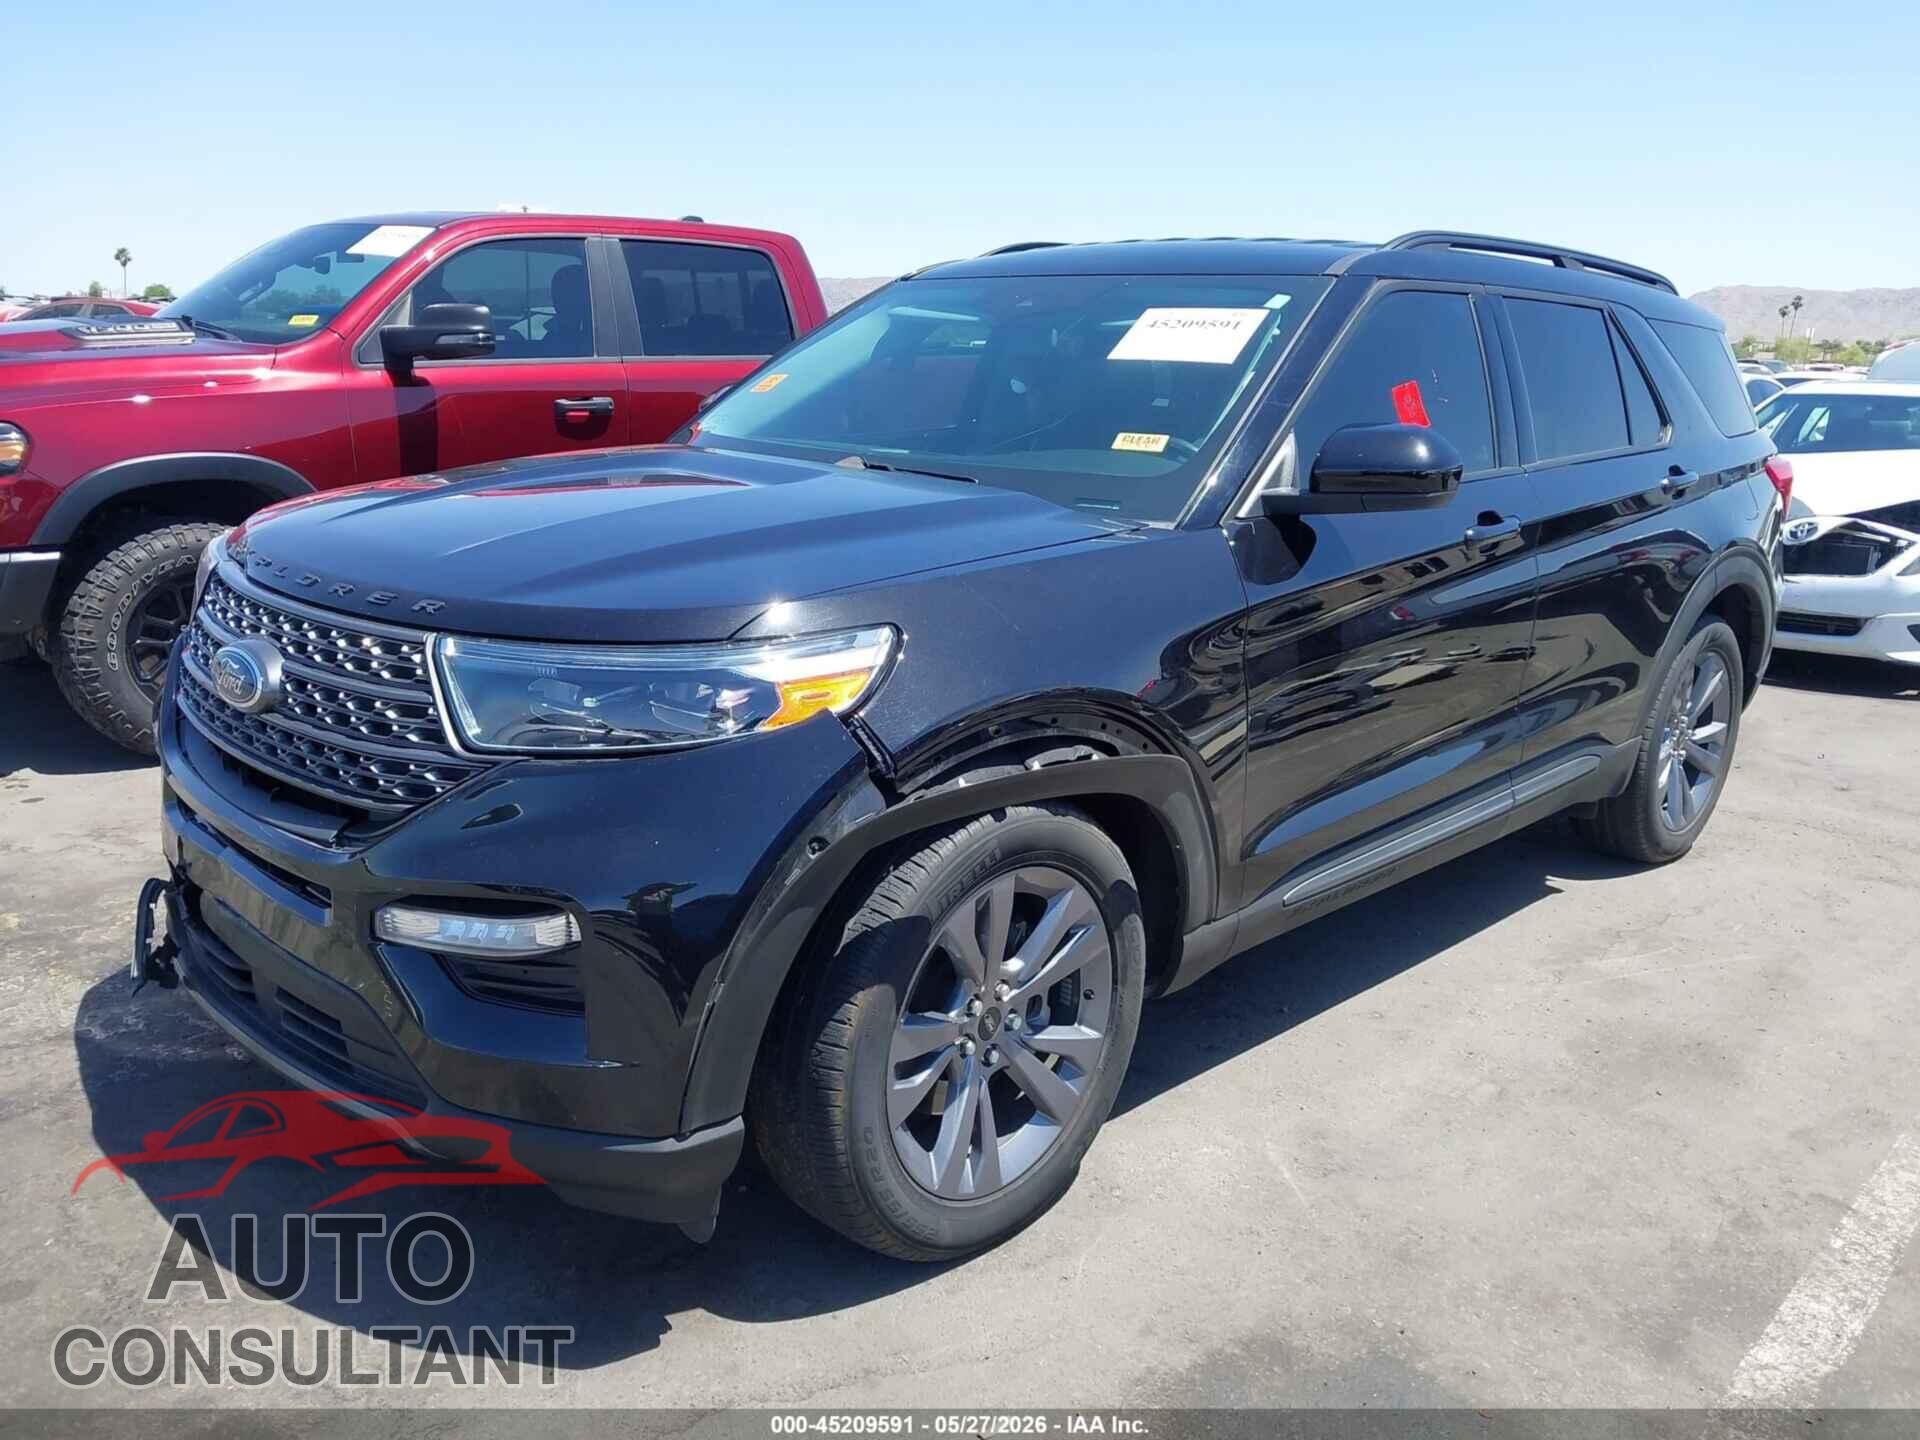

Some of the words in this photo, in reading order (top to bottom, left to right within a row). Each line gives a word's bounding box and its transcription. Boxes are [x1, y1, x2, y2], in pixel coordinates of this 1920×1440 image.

[1145, 319, 1242, 331] 45209591
[247, 549, 448, 615] PLORER
[106, 554, 197, 671] GOODYEA
[216, 656, 245, 696] Ford
